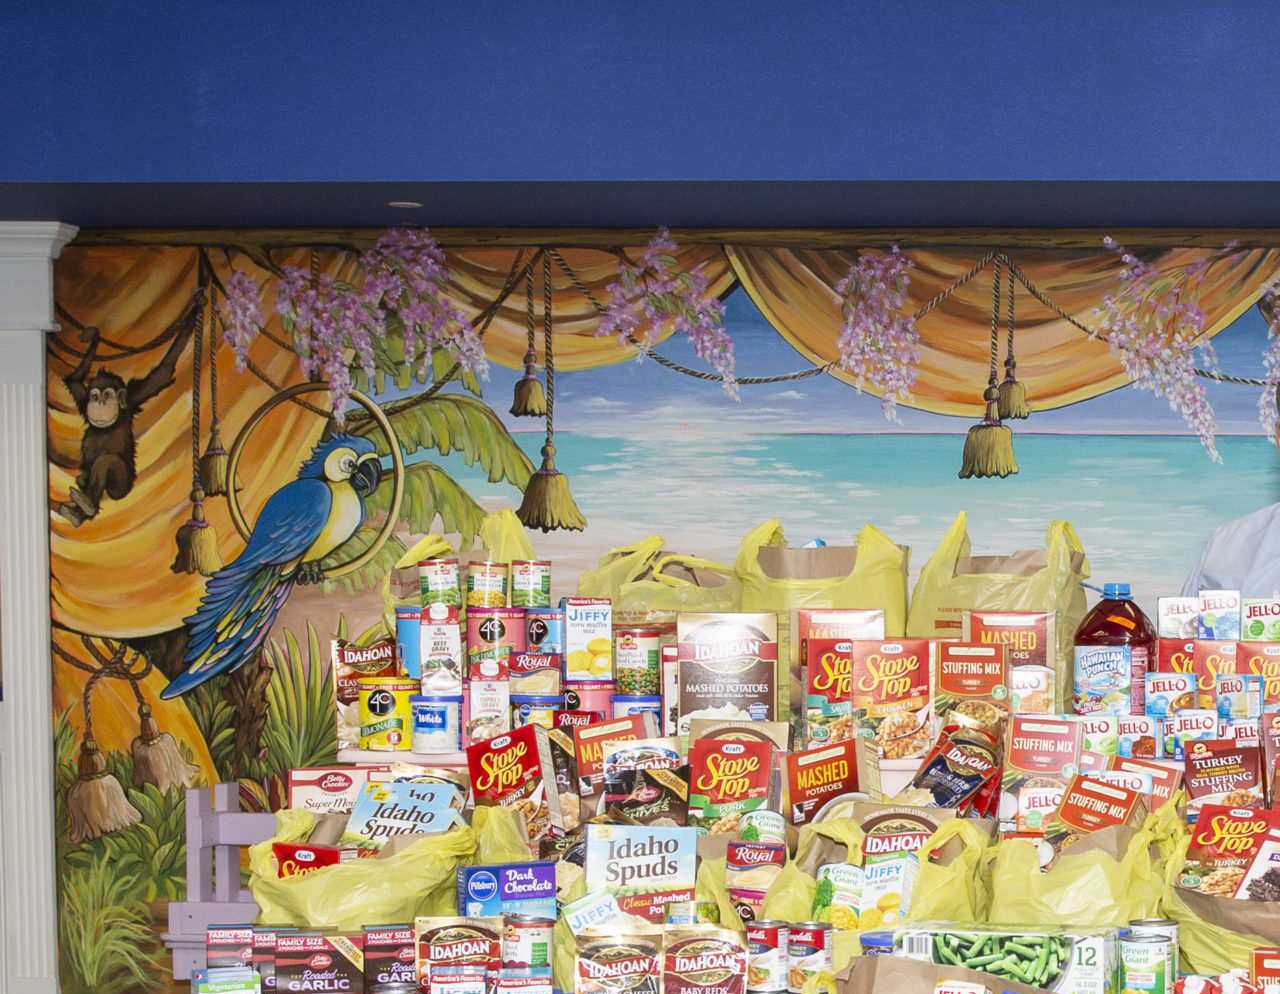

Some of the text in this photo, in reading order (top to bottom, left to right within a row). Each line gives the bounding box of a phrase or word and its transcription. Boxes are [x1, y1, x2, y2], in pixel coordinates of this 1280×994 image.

[569, 609, 609, 622] JIFFY
[981, 631, 1037, 650] MASHED
[344, 646, 392, 664] IDAHOAN
[695, 640, 762, 660] IDAHOAN
[516, 654, 551, 669] Royal
[1079, 651, 1125, 668] HAWAIIAN
[858, 653, 920, 691] Stove
[942, 662, 1001, 675] STUFFING MIX
[686, 684, 769, 692] MASHED POTATOES
[1150, 678, 1187, 694] JELL-O
[877, 701, 913, 714] CHICKEN
[361, 719, 398, 737] LEMONADE
[559, 713, 591, 727] Royal
[1177, 716, 1214, 732] JELL-O
[493, 738, 508, 747] Kraft
[725, 745, 741, 753] Kraft
[1013, 737, 1073, 753] STUFFING MIX
[1193, 754, 1243, 769] TURKEY
[697, 754, 760, 791] Stove
[797, 760, 849, 790] MASHED
[1191, 772, 1253, 788] STUFFING
[499, 786, 525, 806] TURKEY
[718, 777, 750, 800] Top
[806, 782, 843, 797] POTATOES
[1152, 783, 1169, 798] MIX
[1211, 783, 1237, 793] MIX
[371, 803, 435, 824] Idaho
[719, 802, 745, 814] PORK
[1068, 793, 1127, 820] STUFFING MIX
[1197, 816, 1268, 846] Stove
[608, 835, 679, 861] Idaho
[1217, 836, 1254, 854] Top
[297, 851, 313, 860] Kraft
[735, 848, 774, 863] Royal
[1214, 858, 1248, 867] TURKEY
[506, 868, 534, 881] Dark
[605, 858, 678, 886] Spuds
[832, 867, 858, 878] Green
[866, 864, 903, 880] JIFFY
[470, 880, 496, 892] Pillsbury
[504, 879, 553, 895] Chocolate
[623, 892, 691, 910] Classic Mashed
[572, 901, 615, 930] JIFFY
[430, 942, 490, 959] IDAHOAN
[1076, 947, 1097, 967] 12
[1123, 946, 1149, 955] Green
[302, 968, 337, 980] Roasted
[588, 958, 649, 977] IDAHOAN
[207, 982, 246, 992] Vegetarian
[288, 979, 350, 991] GARLIC
